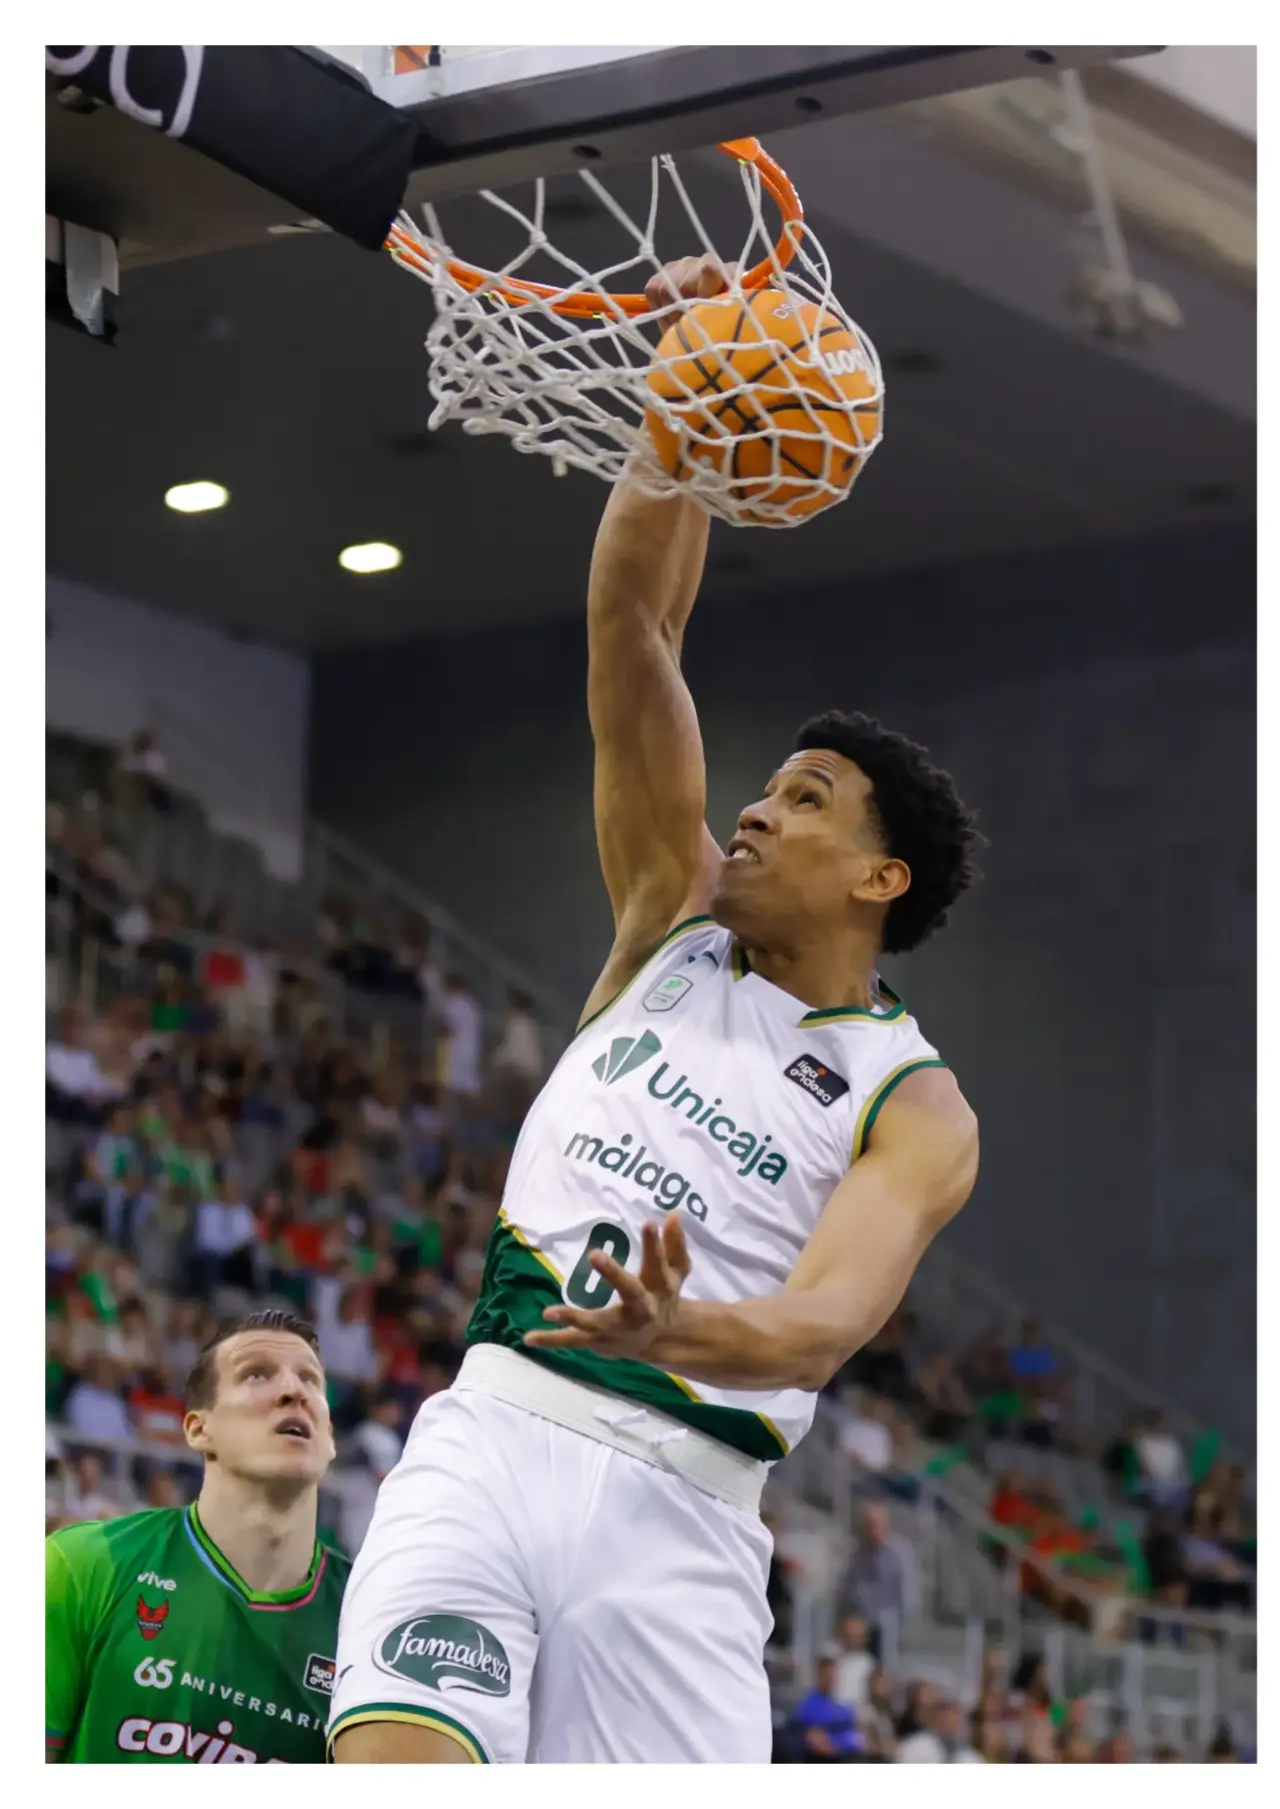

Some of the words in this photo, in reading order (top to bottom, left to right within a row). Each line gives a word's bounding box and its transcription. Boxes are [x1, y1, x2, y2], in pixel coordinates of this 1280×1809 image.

[790, 1068, 832, 1103] endesa
[797, 1060, 819, 1079] liga
[647, 1061, 789, 1186] Unicaja
[386, 1618, 509, 1685] famadesa
[134, 1656, 178, 1689] 65
[311, 1664, 333, 1679] liga
